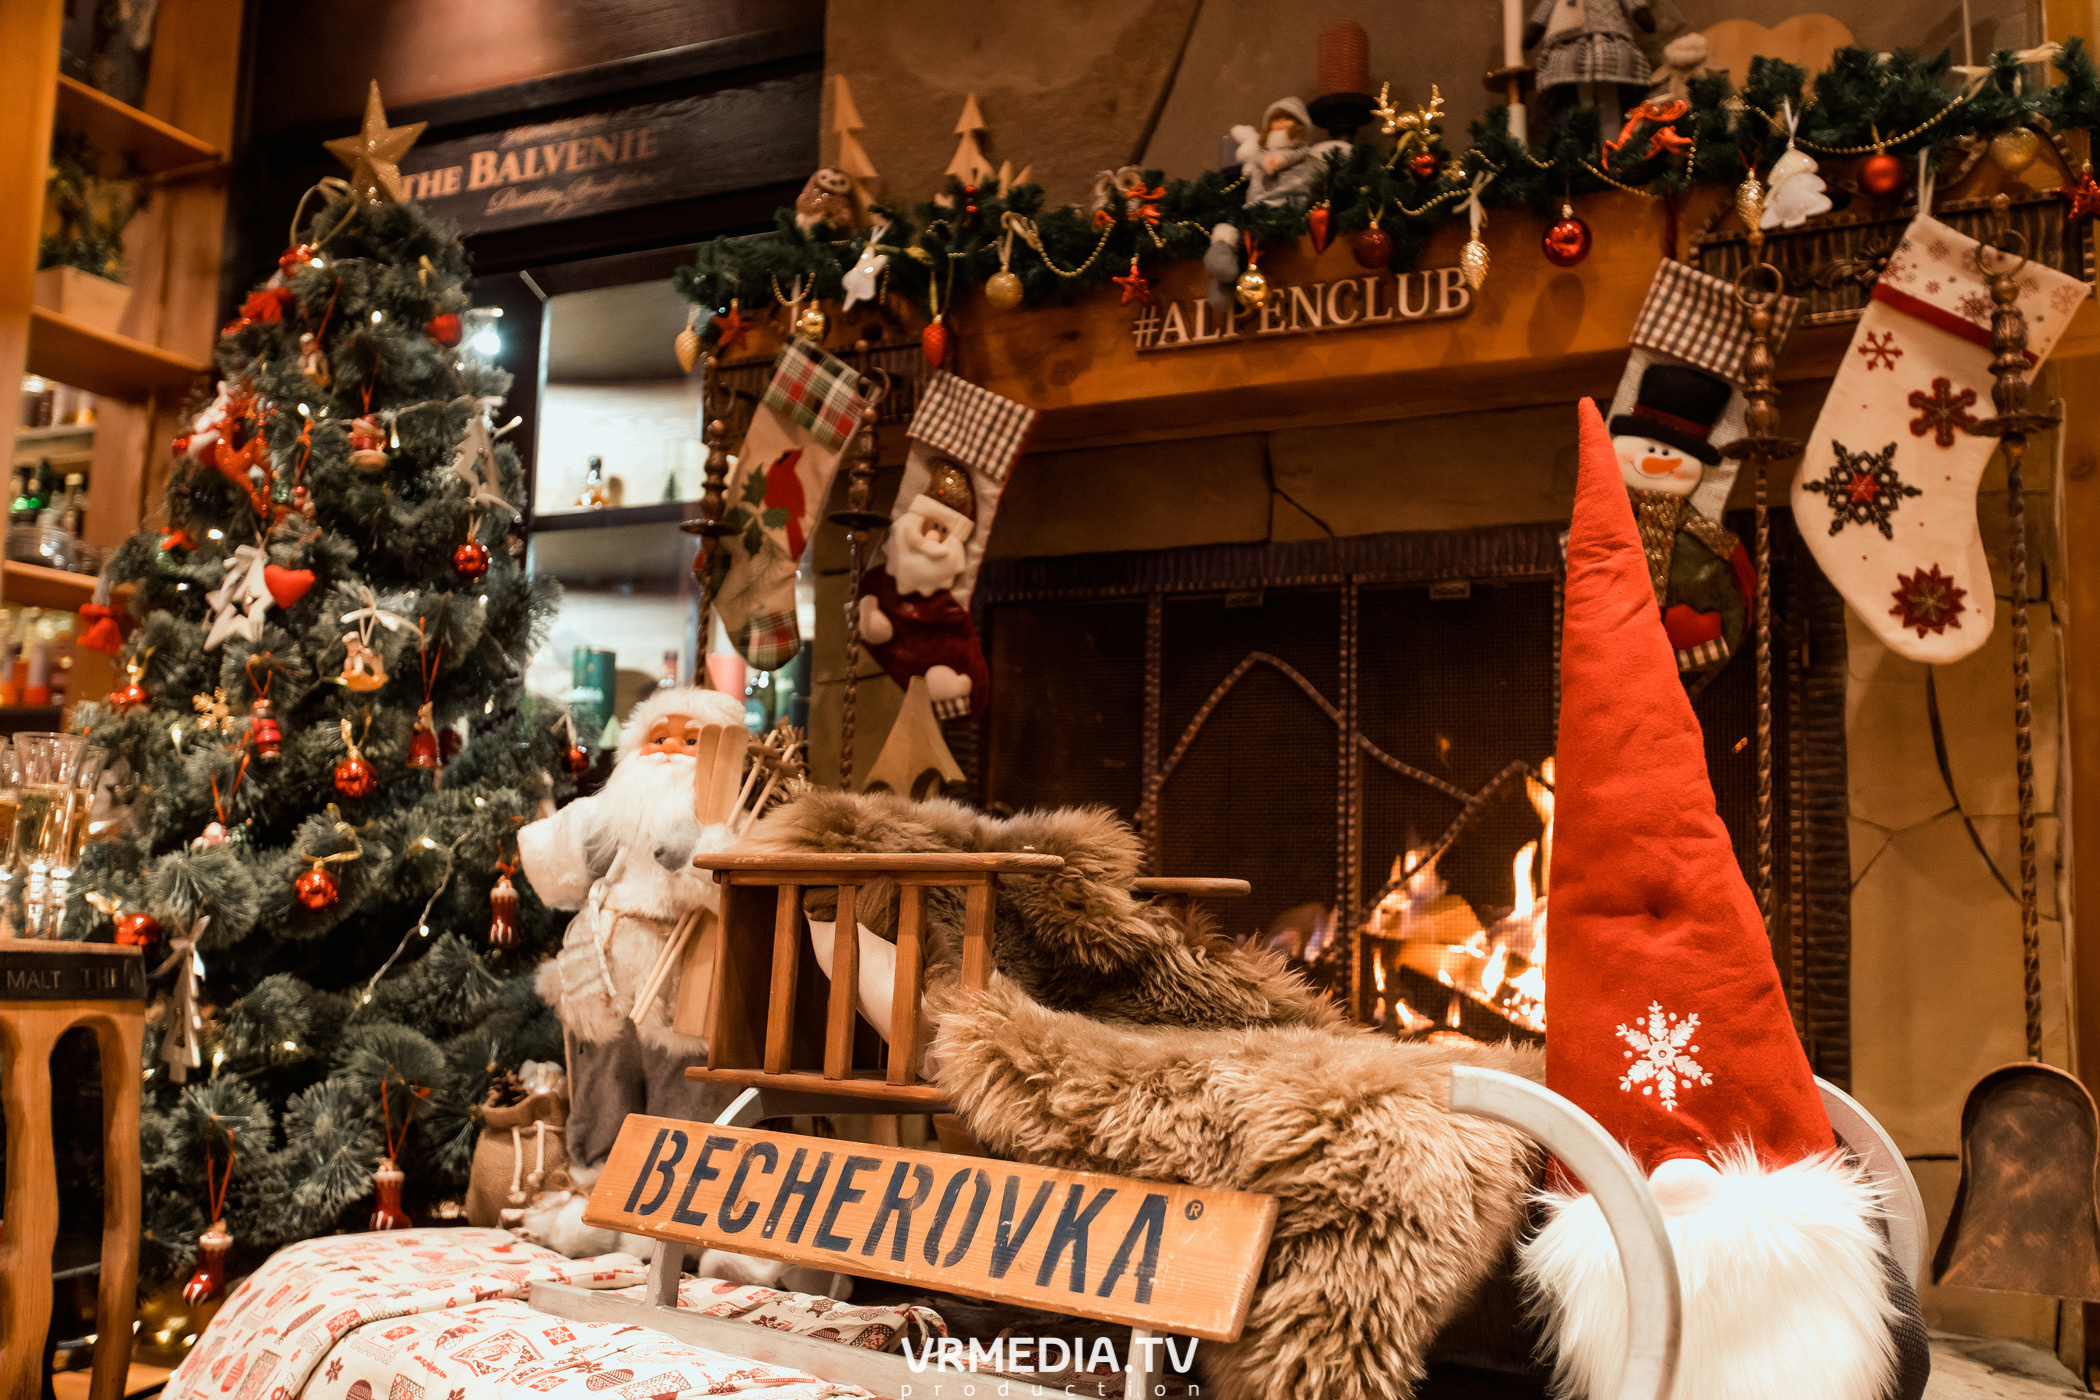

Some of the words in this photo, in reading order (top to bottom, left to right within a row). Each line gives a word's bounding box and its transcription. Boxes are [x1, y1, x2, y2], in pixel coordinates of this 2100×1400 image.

[399, 165, 463, 201] THE
[466, 128, 659, 191] BALVENIE
[7, 969, 61, 990] MALT
